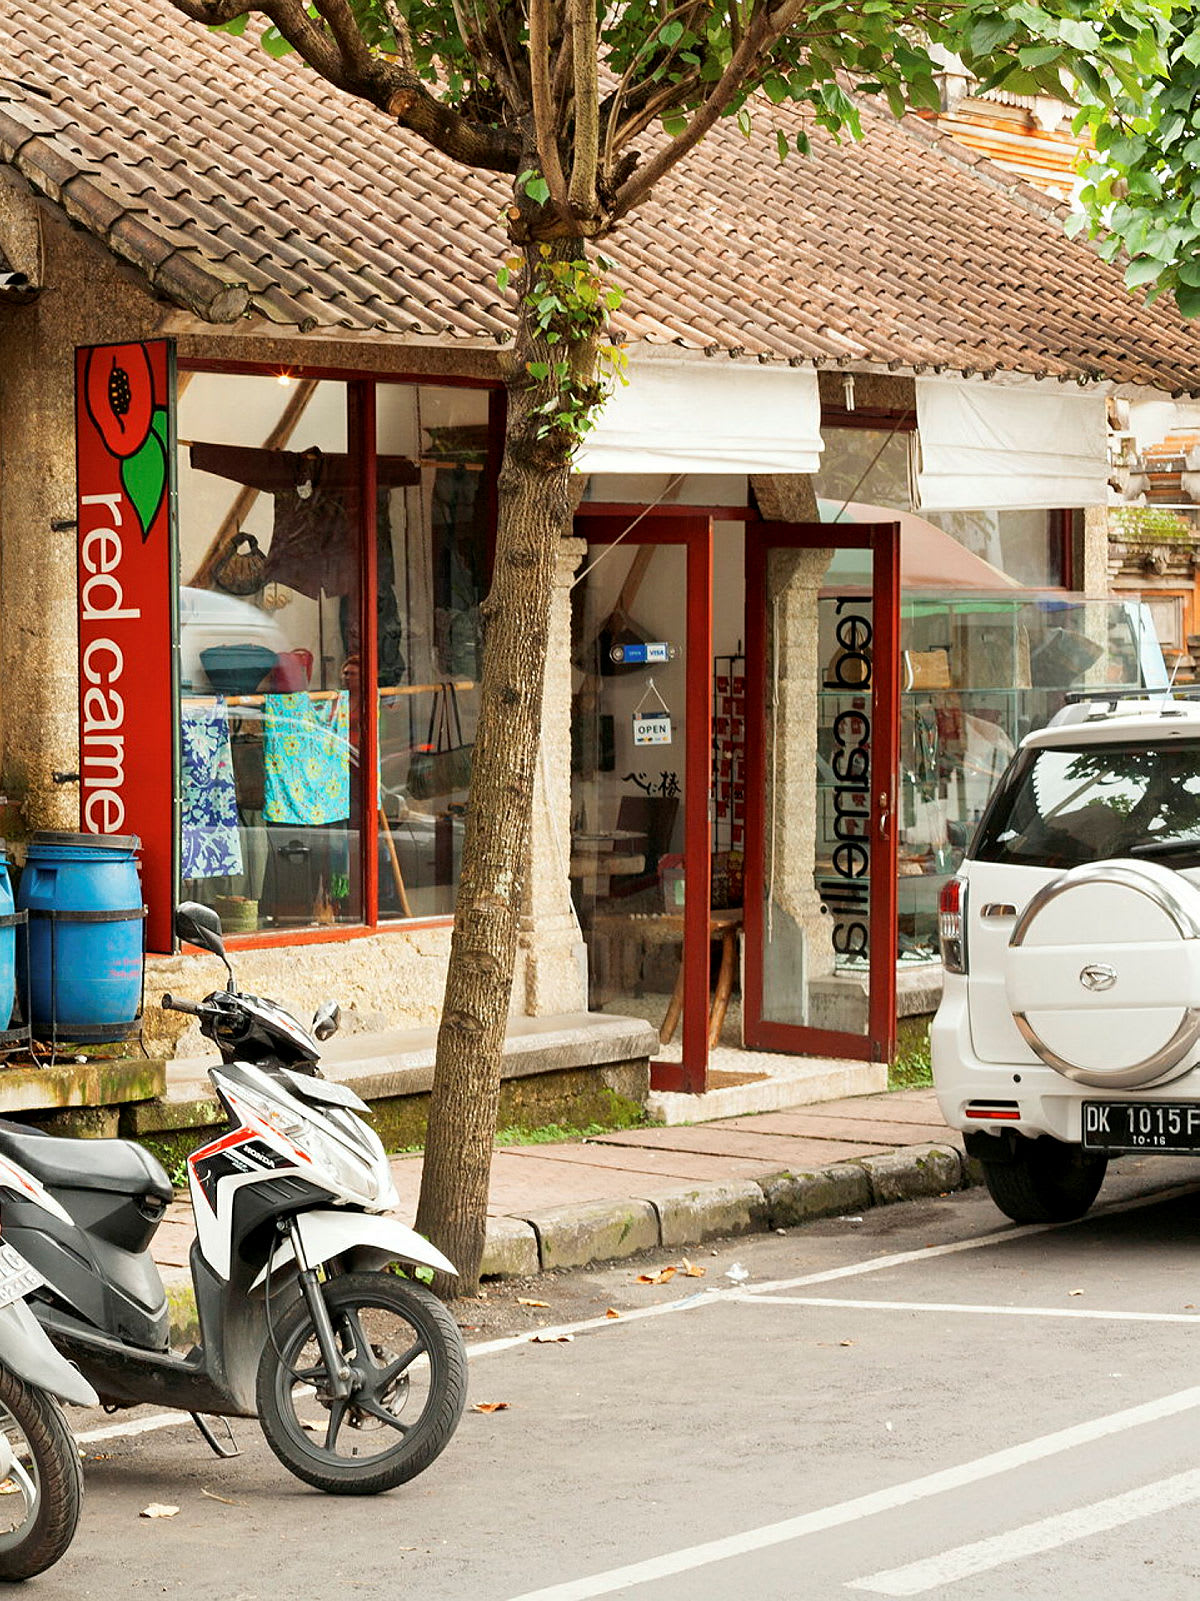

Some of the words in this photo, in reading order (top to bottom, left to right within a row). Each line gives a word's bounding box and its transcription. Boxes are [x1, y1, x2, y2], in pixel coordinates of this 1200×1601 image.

[81, 492, 141, 620] red
[82, 637, 126, 835] came
[638, 724, 667, 735] OPEN
[1087, 1106, 1111, 1132] DK
[1127, 1107, 1181, 1134] 1015
[243, 1144, 275, 1169] HONDA
